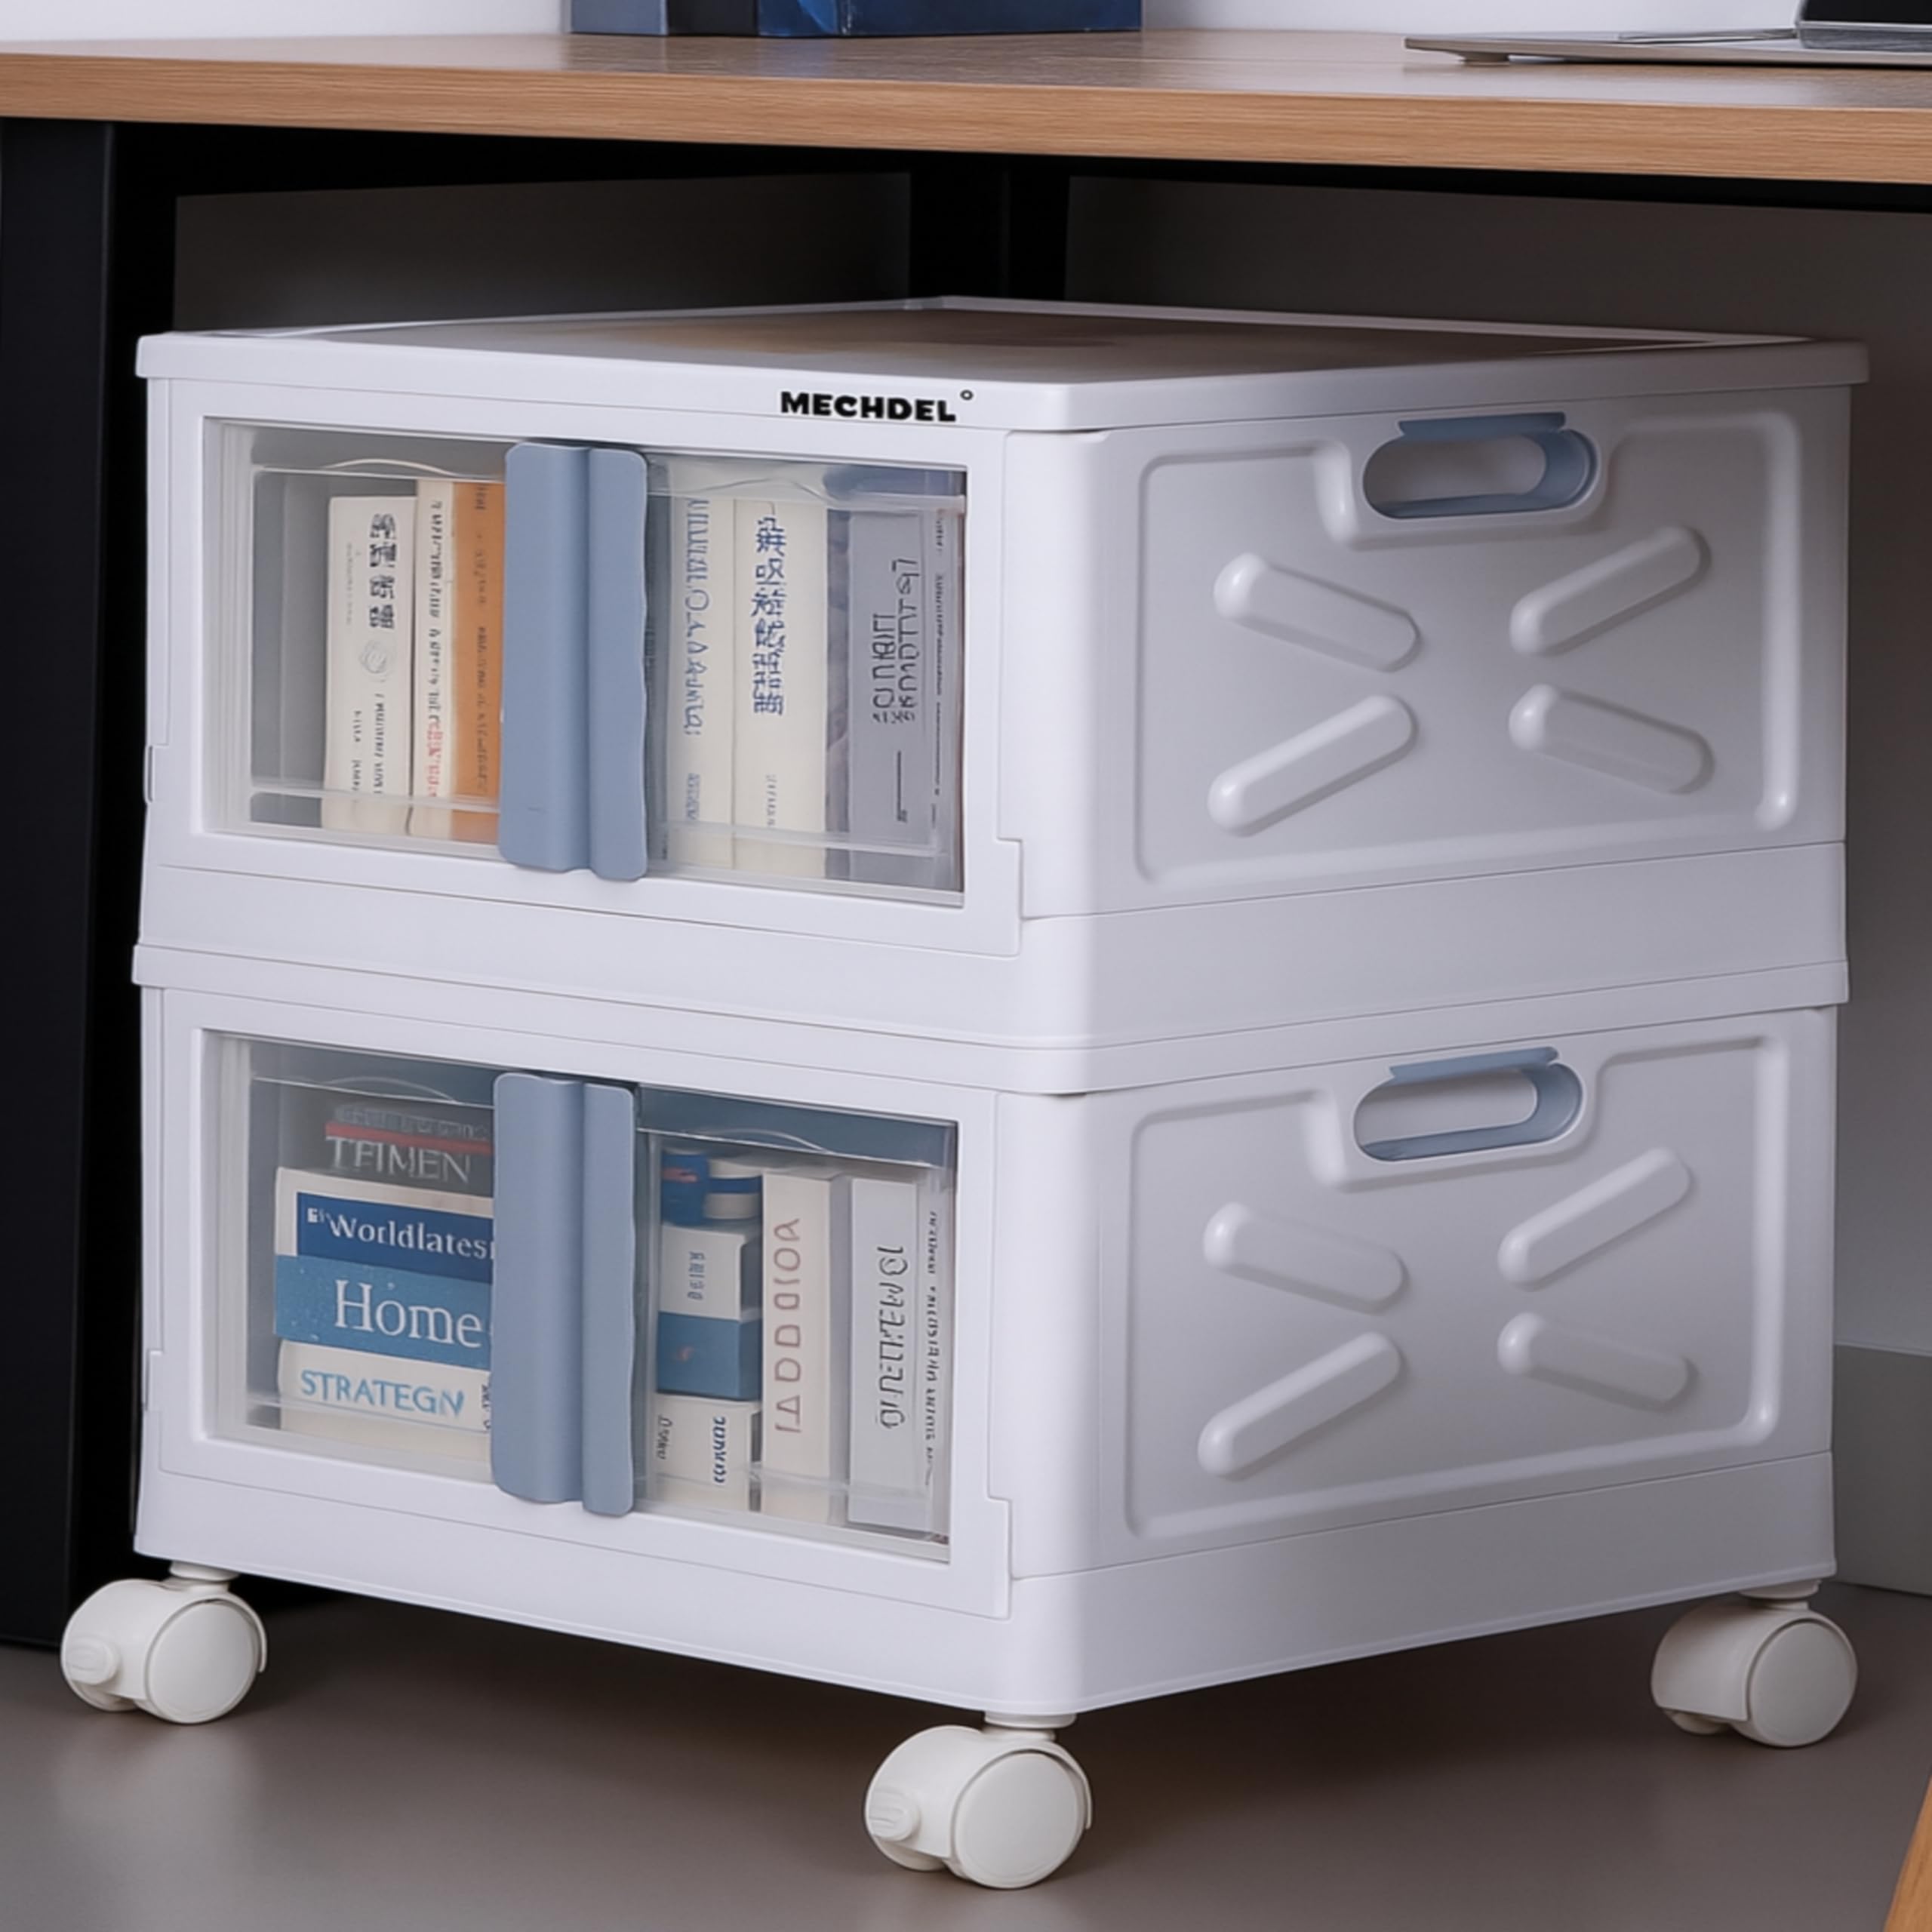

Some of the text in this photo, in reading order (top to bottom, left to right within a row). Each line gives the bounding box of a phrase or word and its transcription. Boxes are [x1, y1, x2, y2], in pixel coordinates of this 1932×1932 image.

[780, 391, 956, 422] MECHDEL
[327, 1213, 494, 1260] Worldlates
[334, 1280, 483, 1348] Home
